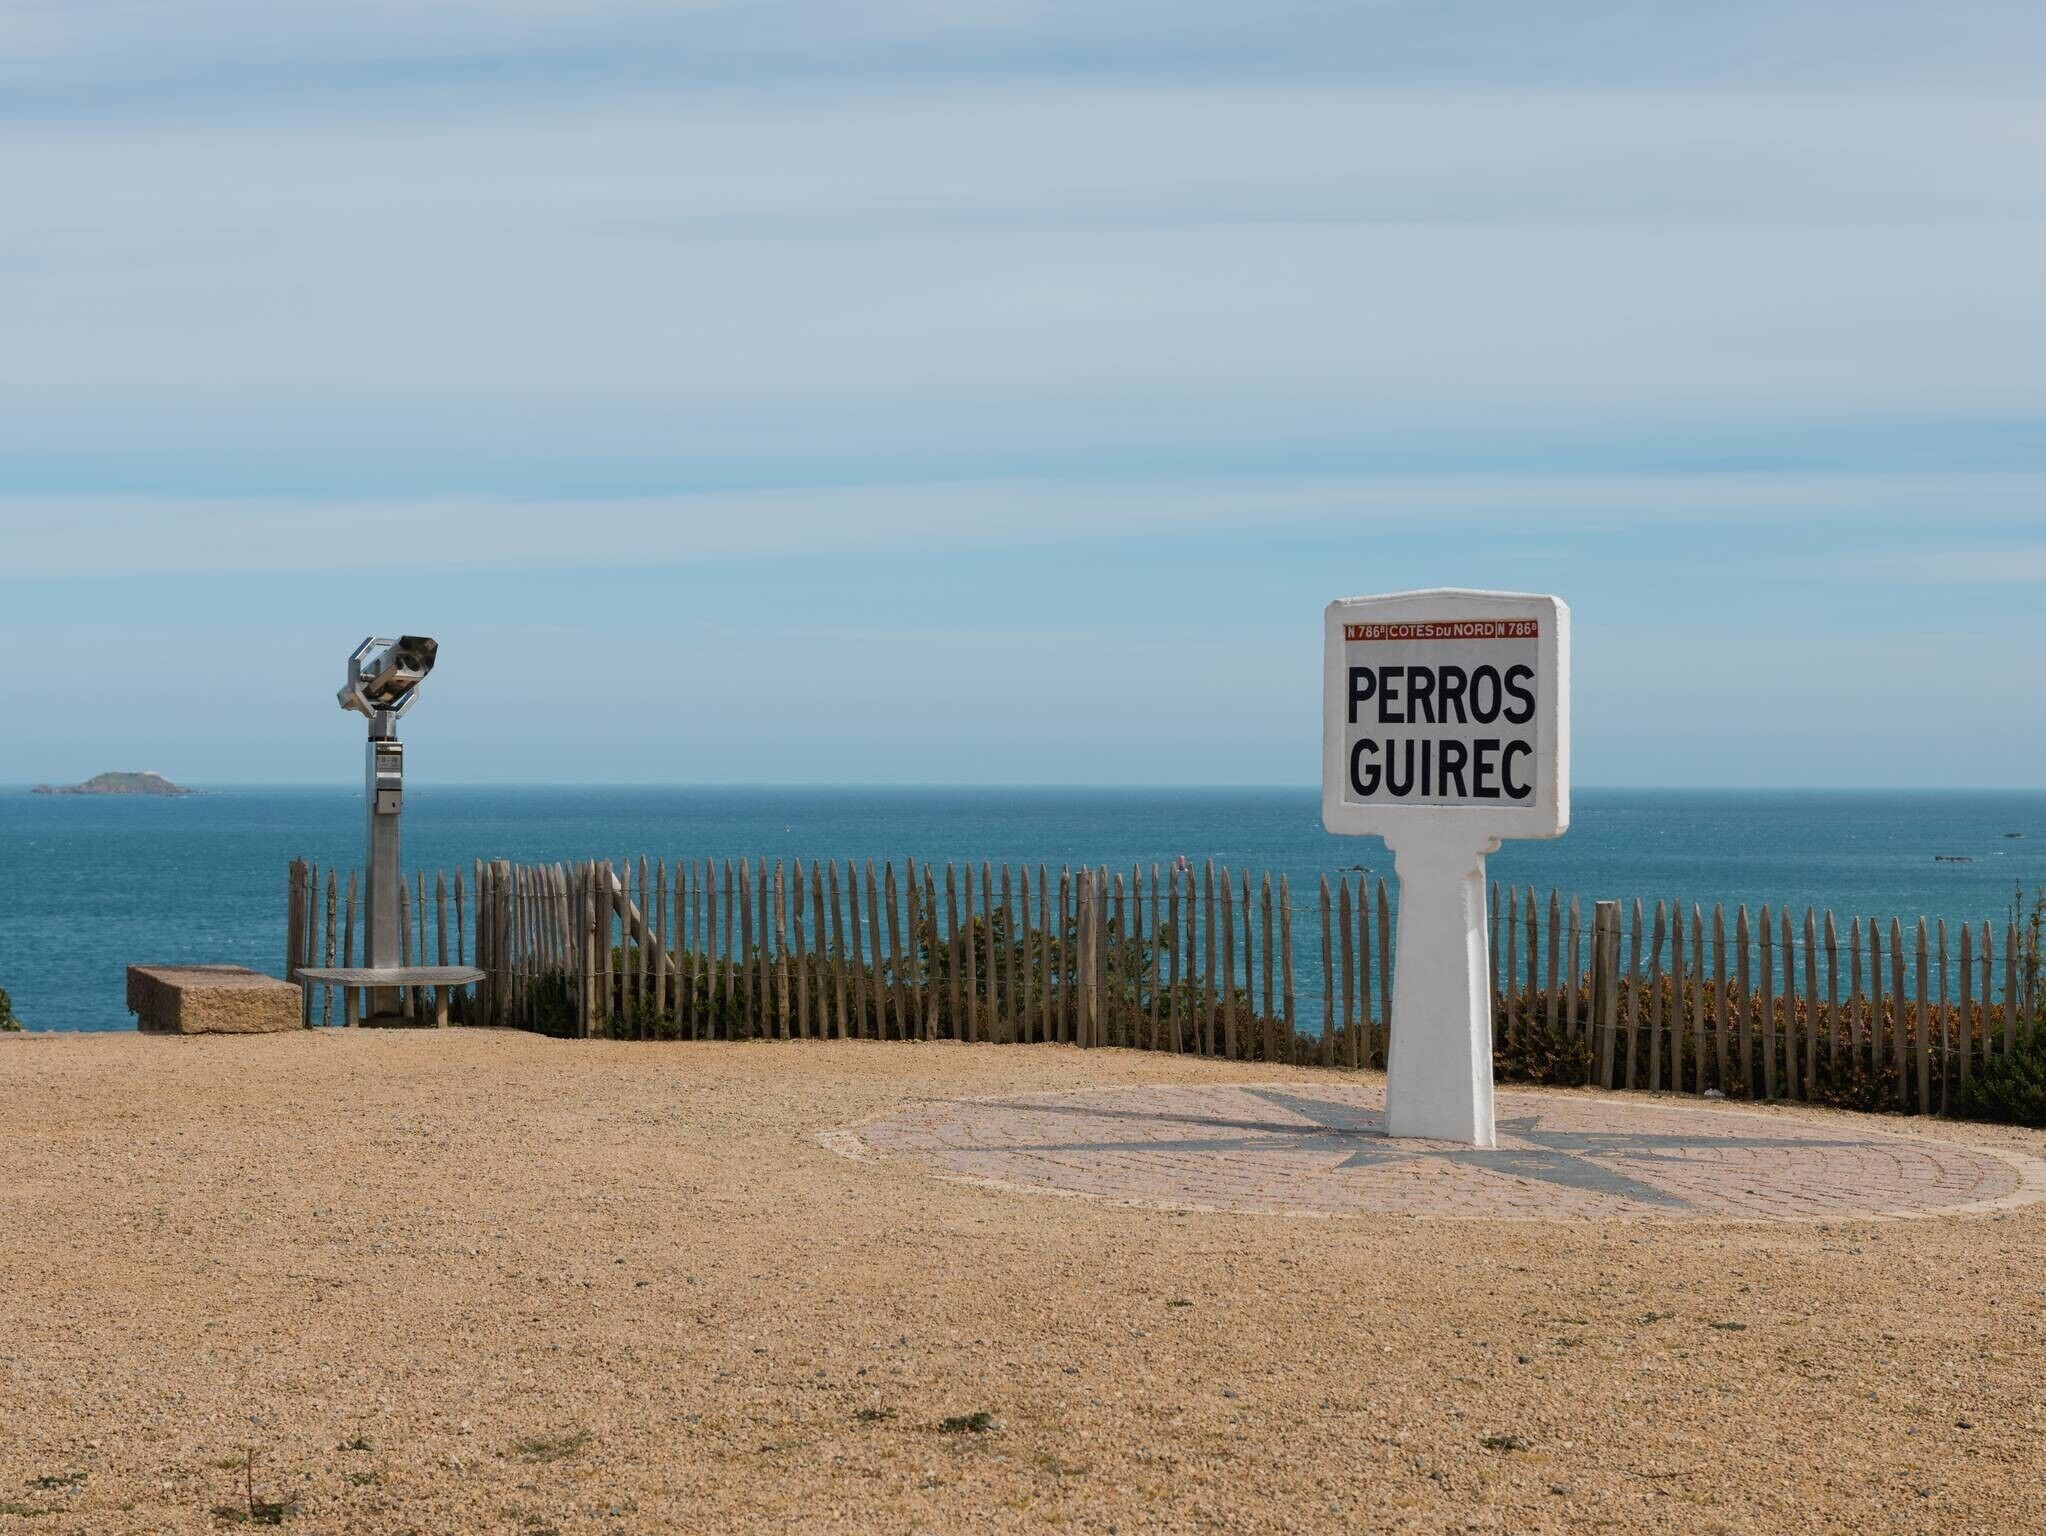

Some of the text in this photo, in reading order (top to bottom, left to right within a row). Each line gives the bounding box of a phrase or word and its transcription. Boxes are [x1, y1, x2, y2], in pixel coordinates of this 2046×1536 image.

[1347, 626, 1355, 638] N
[1388, 624, 1435, 638] COTES
[1436, 626, 1453, 636] DU
[1454, 623, 1494, 637] NORD
[1497, 623, 1505, 636] N
[1348, 664, 1536, 725] PERROS
[1350, 738, 1533, 799] GUIREC
